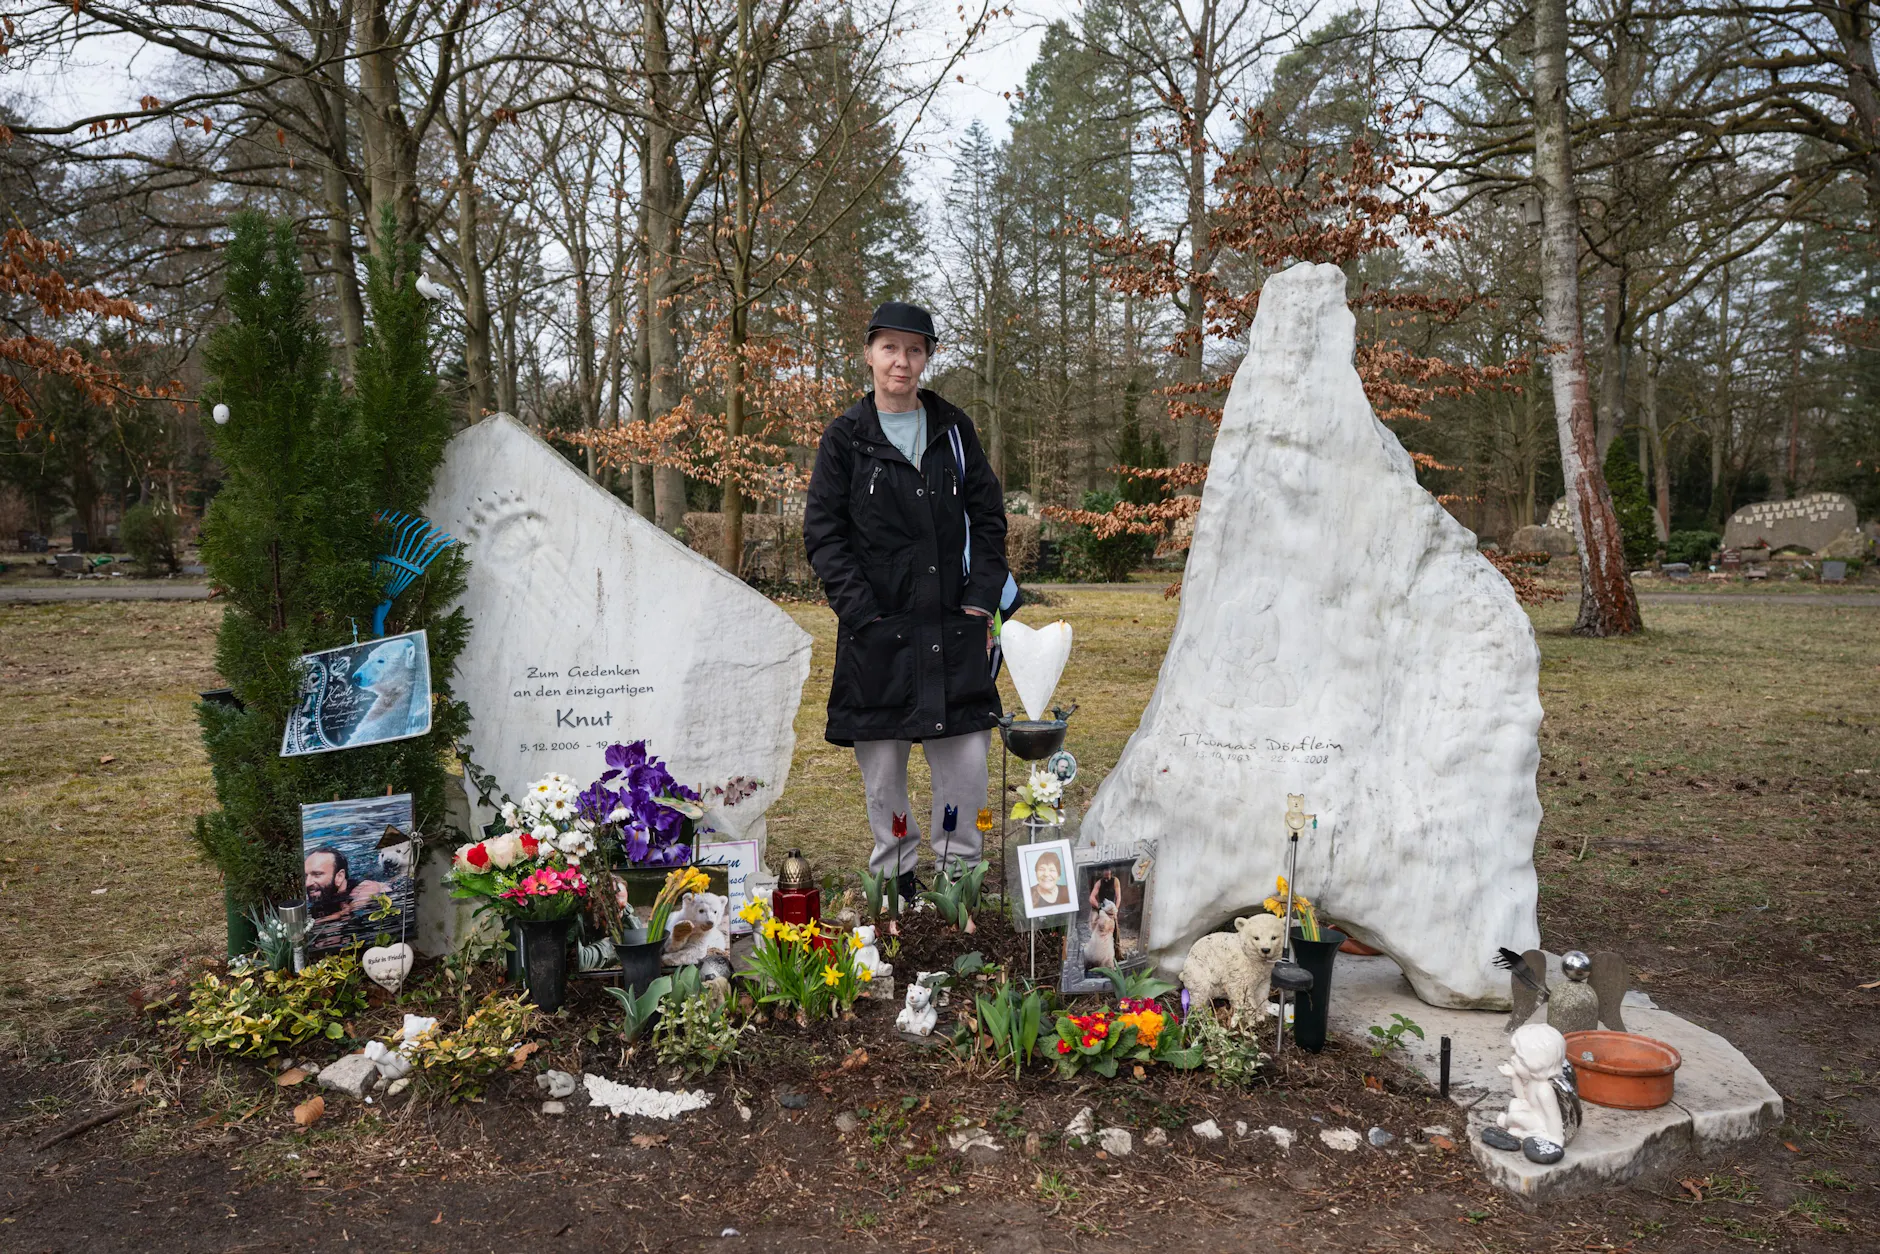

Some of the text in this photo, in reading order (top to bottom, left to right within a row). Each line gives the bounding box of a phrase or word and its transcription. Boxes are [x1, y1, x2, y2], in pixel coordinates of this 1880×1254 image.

[527, 665, 640, 679] Zum Gedenken
[513, 684, 654, 698] an den einzigartigen
[556, 708, 613, 728] Knut
[520, 743, 530, 753] 5.
[532, 742, 548, 751] 12.
[551, 741, 580, 751] 2006
[1179, 732, 1344, 753] Thomas Dörflein
[1304, 755, 1329, 764] 2008
[1094, 842, 1135, 863] BERLIN
[368, 957, 380, 965] Ruhe
[387, 953, 406, 961] Friedn
